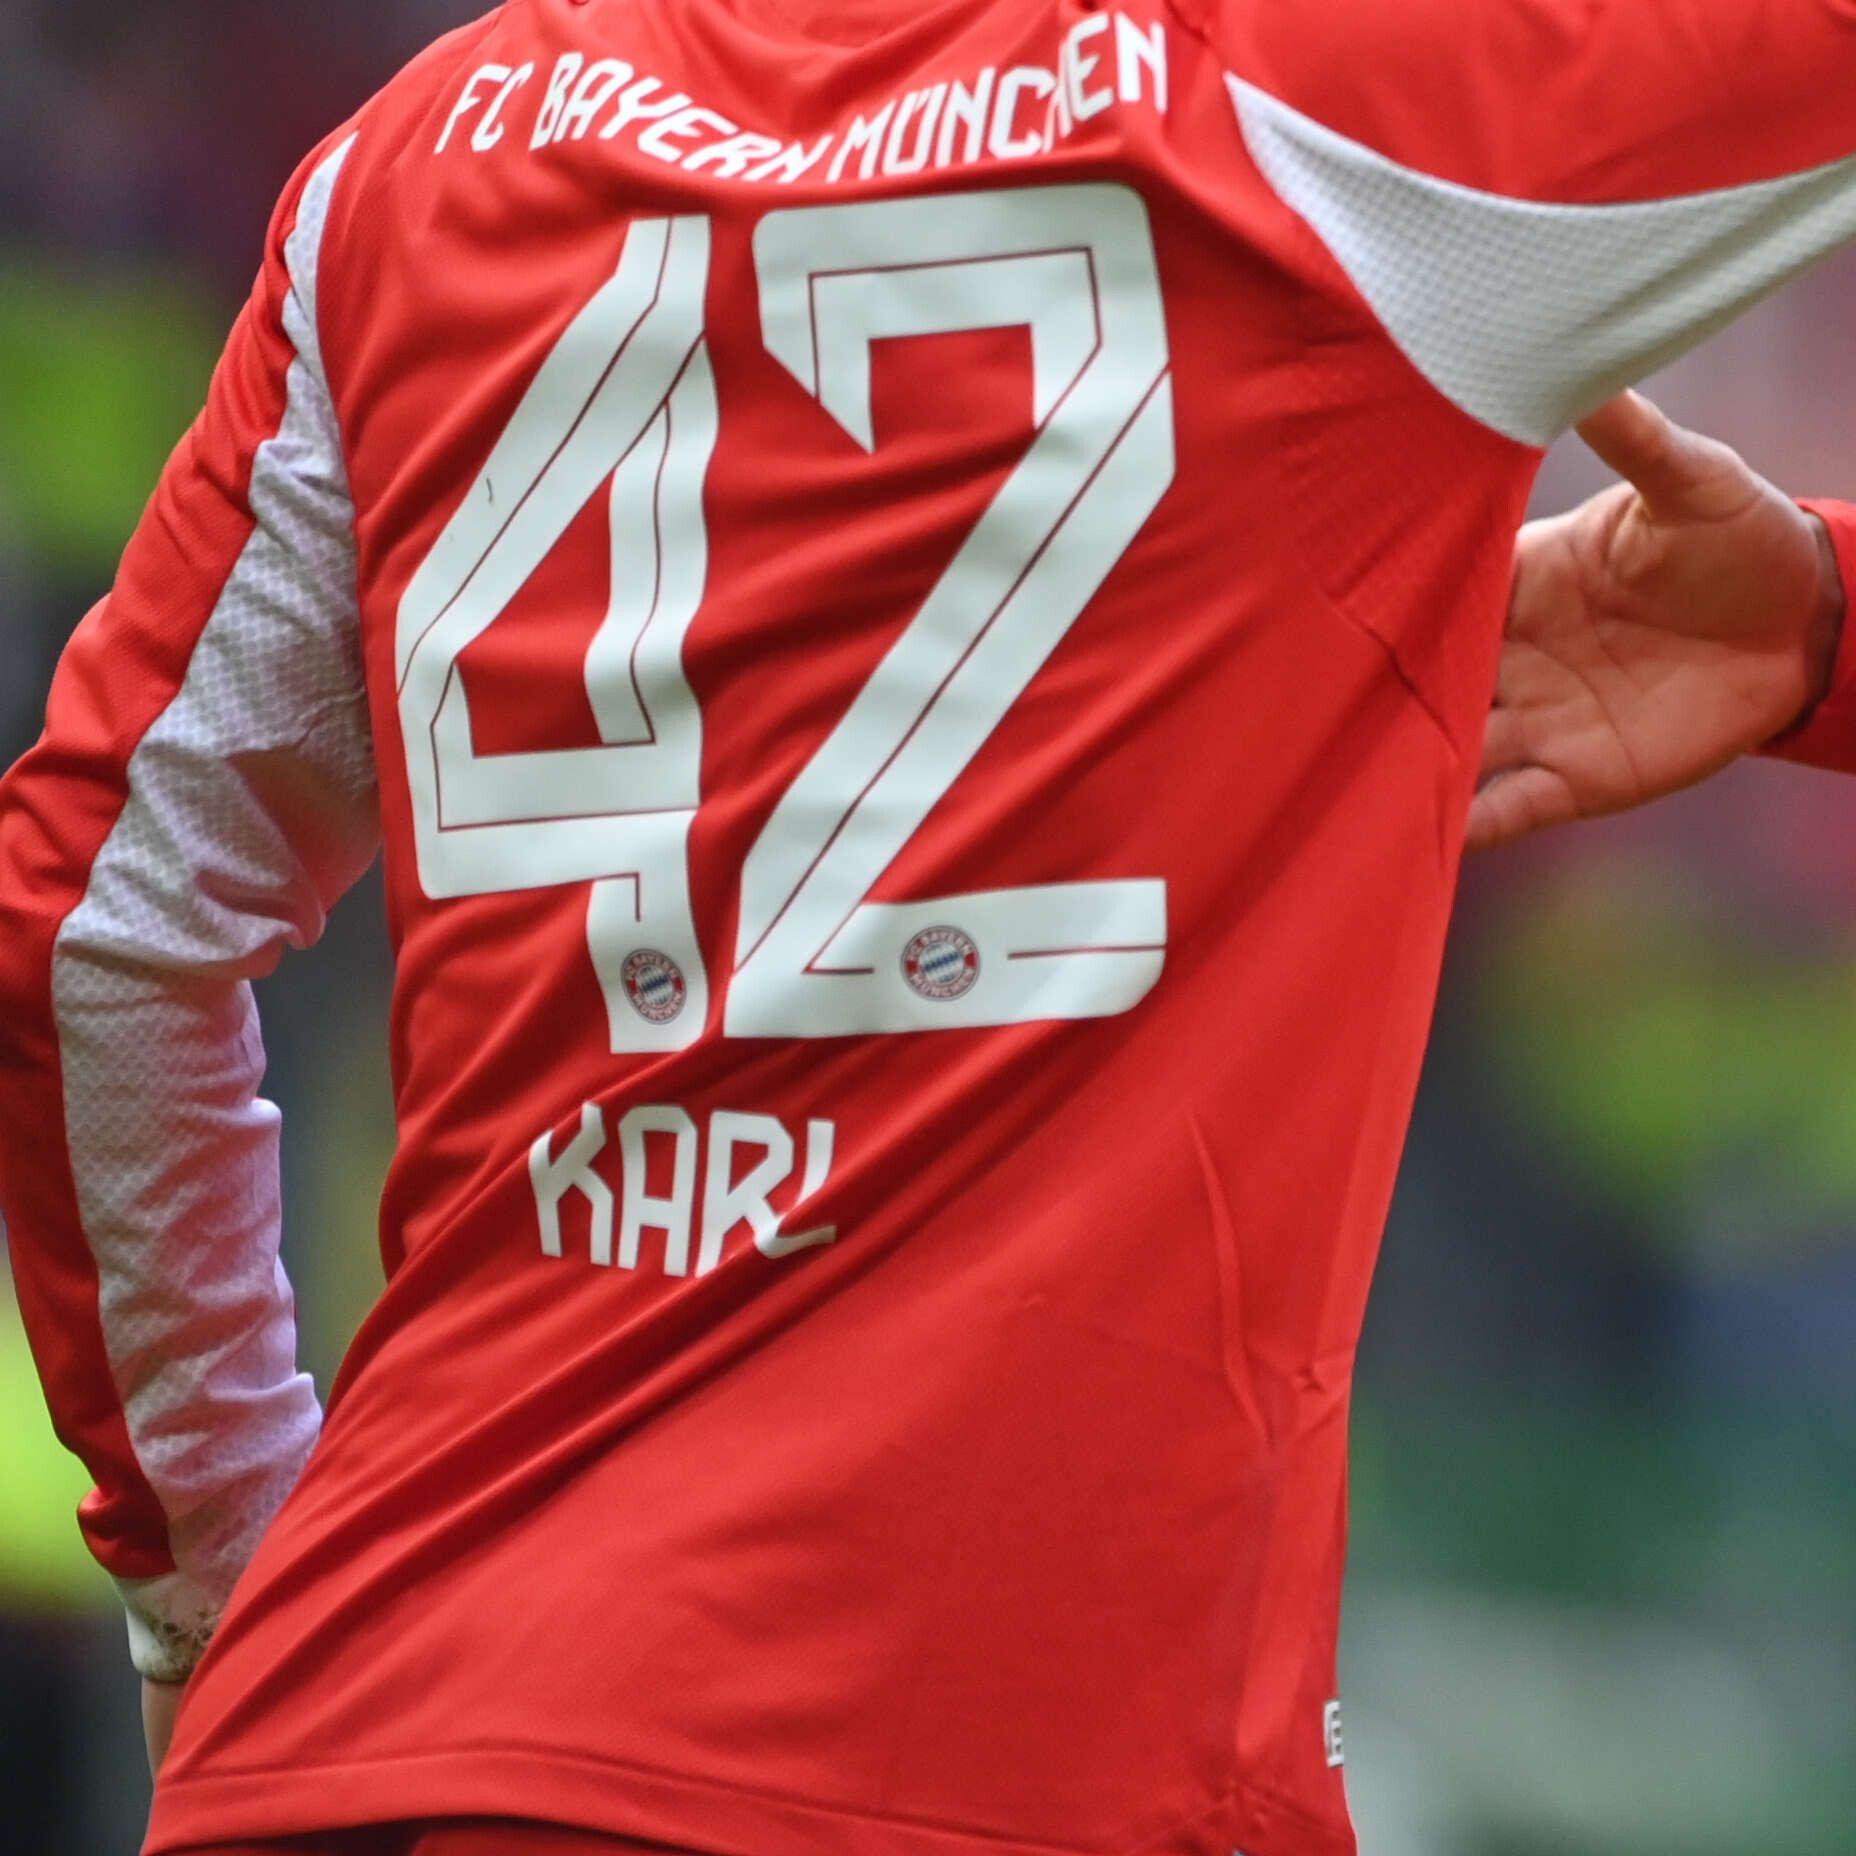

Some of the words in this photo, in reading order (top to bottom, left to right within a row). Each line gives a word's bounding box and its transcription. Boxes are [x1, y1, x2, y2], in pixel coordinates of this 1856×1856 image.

[435, 60, 533, 153] FC
[530, 52, 835, 185] BAYERN
[825, 11, 1168, 185] MÜNCHEN
[395, 180, 1176, 1054] 42
[528, 1100, 837, 1278] KARL
